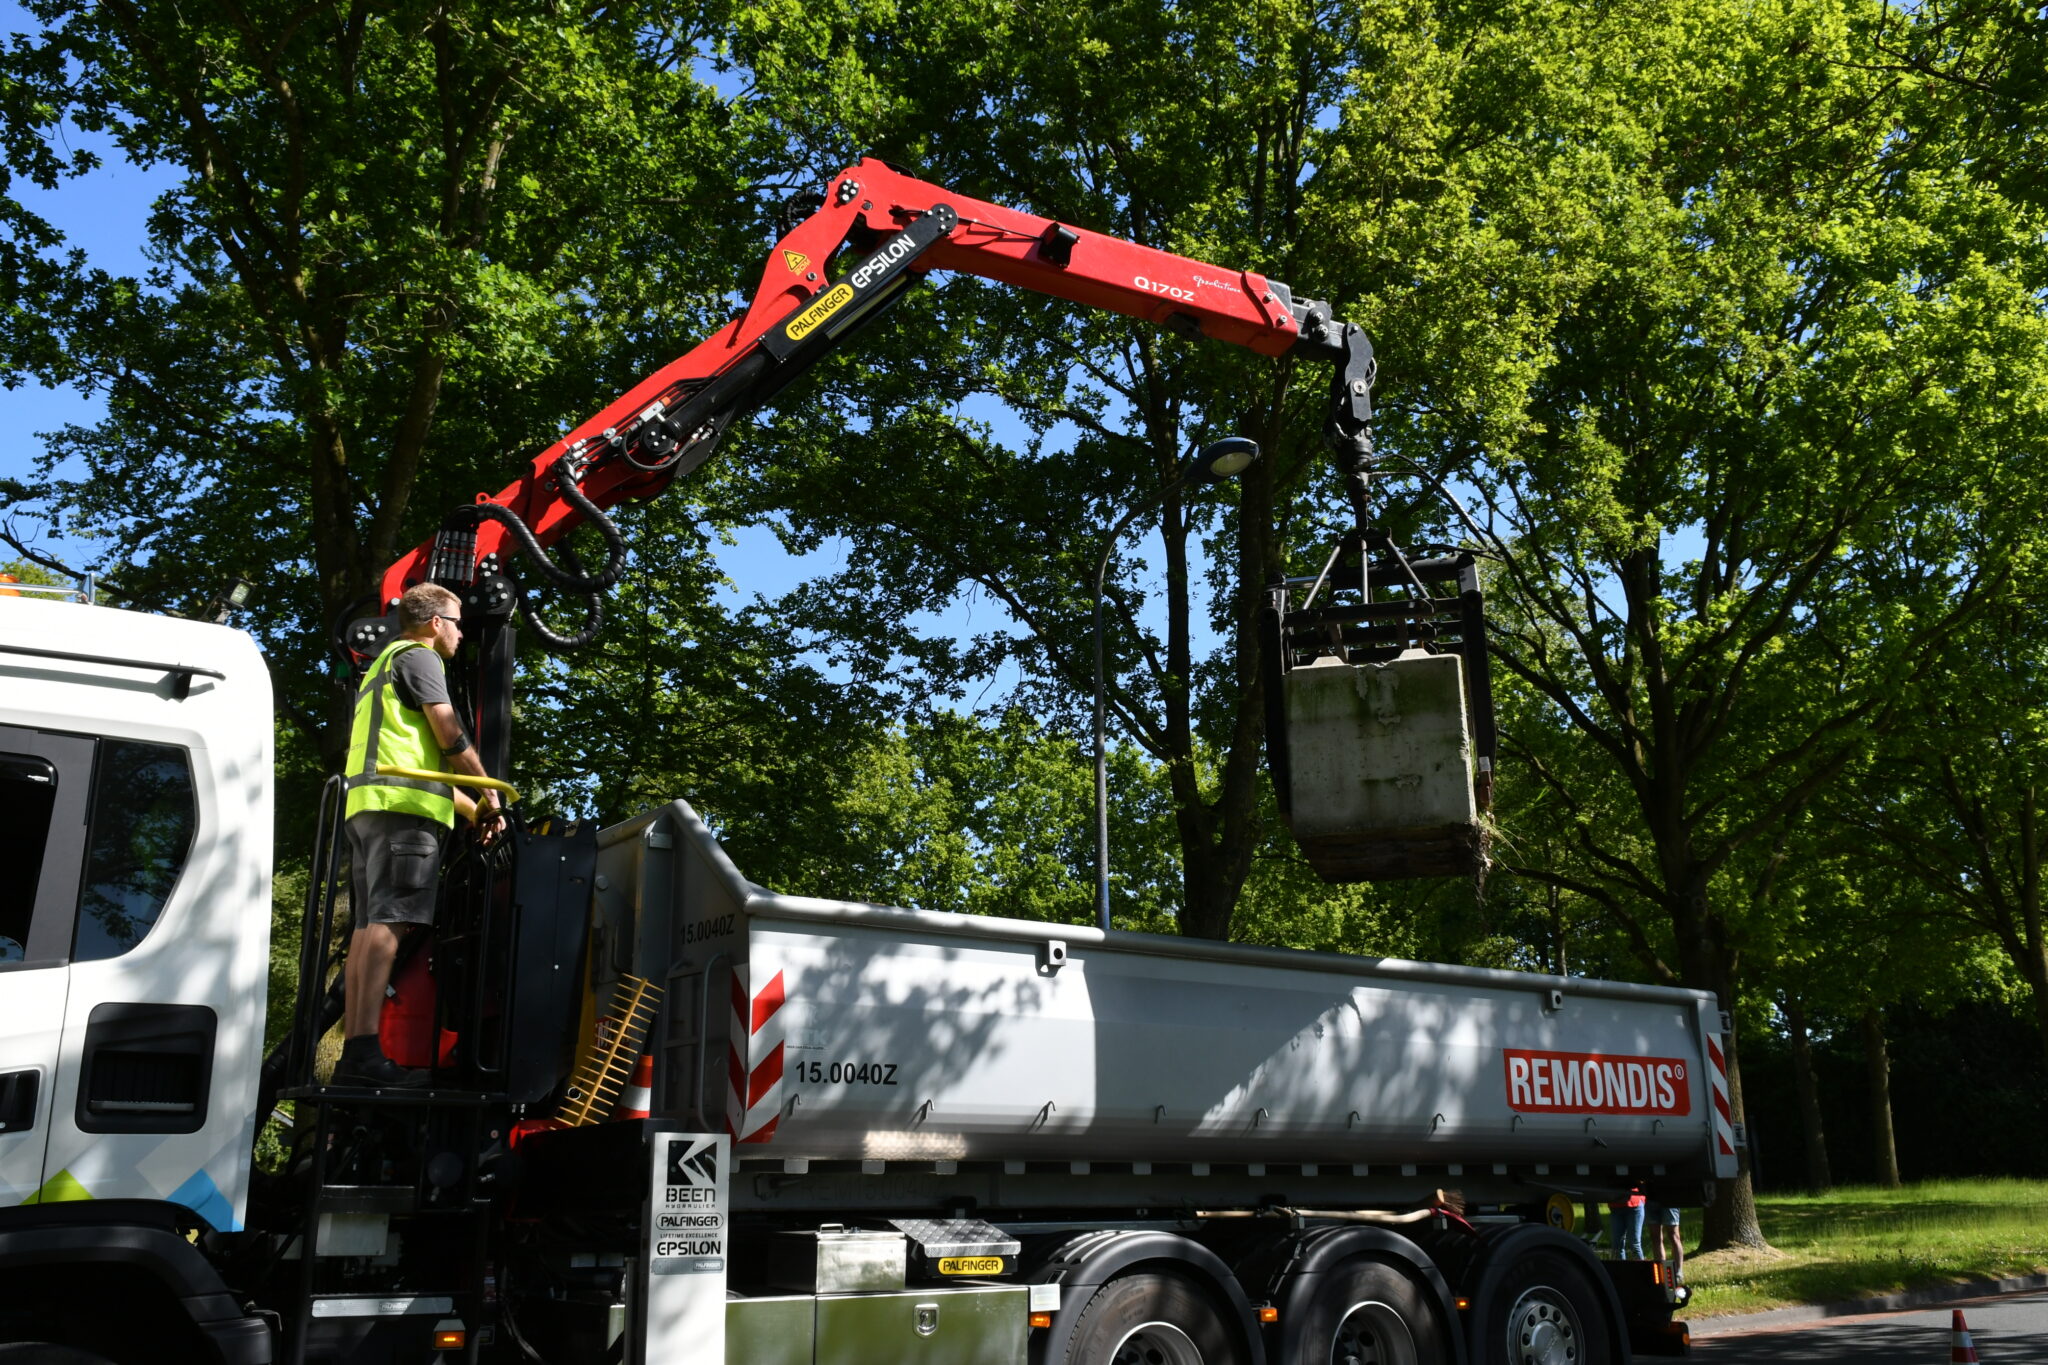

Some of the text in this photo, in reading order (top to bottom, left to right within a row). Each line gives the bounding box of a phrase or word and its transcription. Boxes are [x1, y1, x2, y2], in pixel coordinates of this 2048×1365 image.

[851, 234, 916, 288] EPSILON
[1134, 276, 1195, 301] Q170Z
[789, 287, 850, 337] PALFINGER
[680, 913, 735, 944] 15.0040Z
[795, 1061, 898, 1085] 15.0040Z
[665, 1188, 716, 1202] BEEN
[660, 1216, 719, 1227] PALFINGER
[657, 1241, 721, 1255] EPSILON
[943, 1260, 999, 1271] PALFINGER
